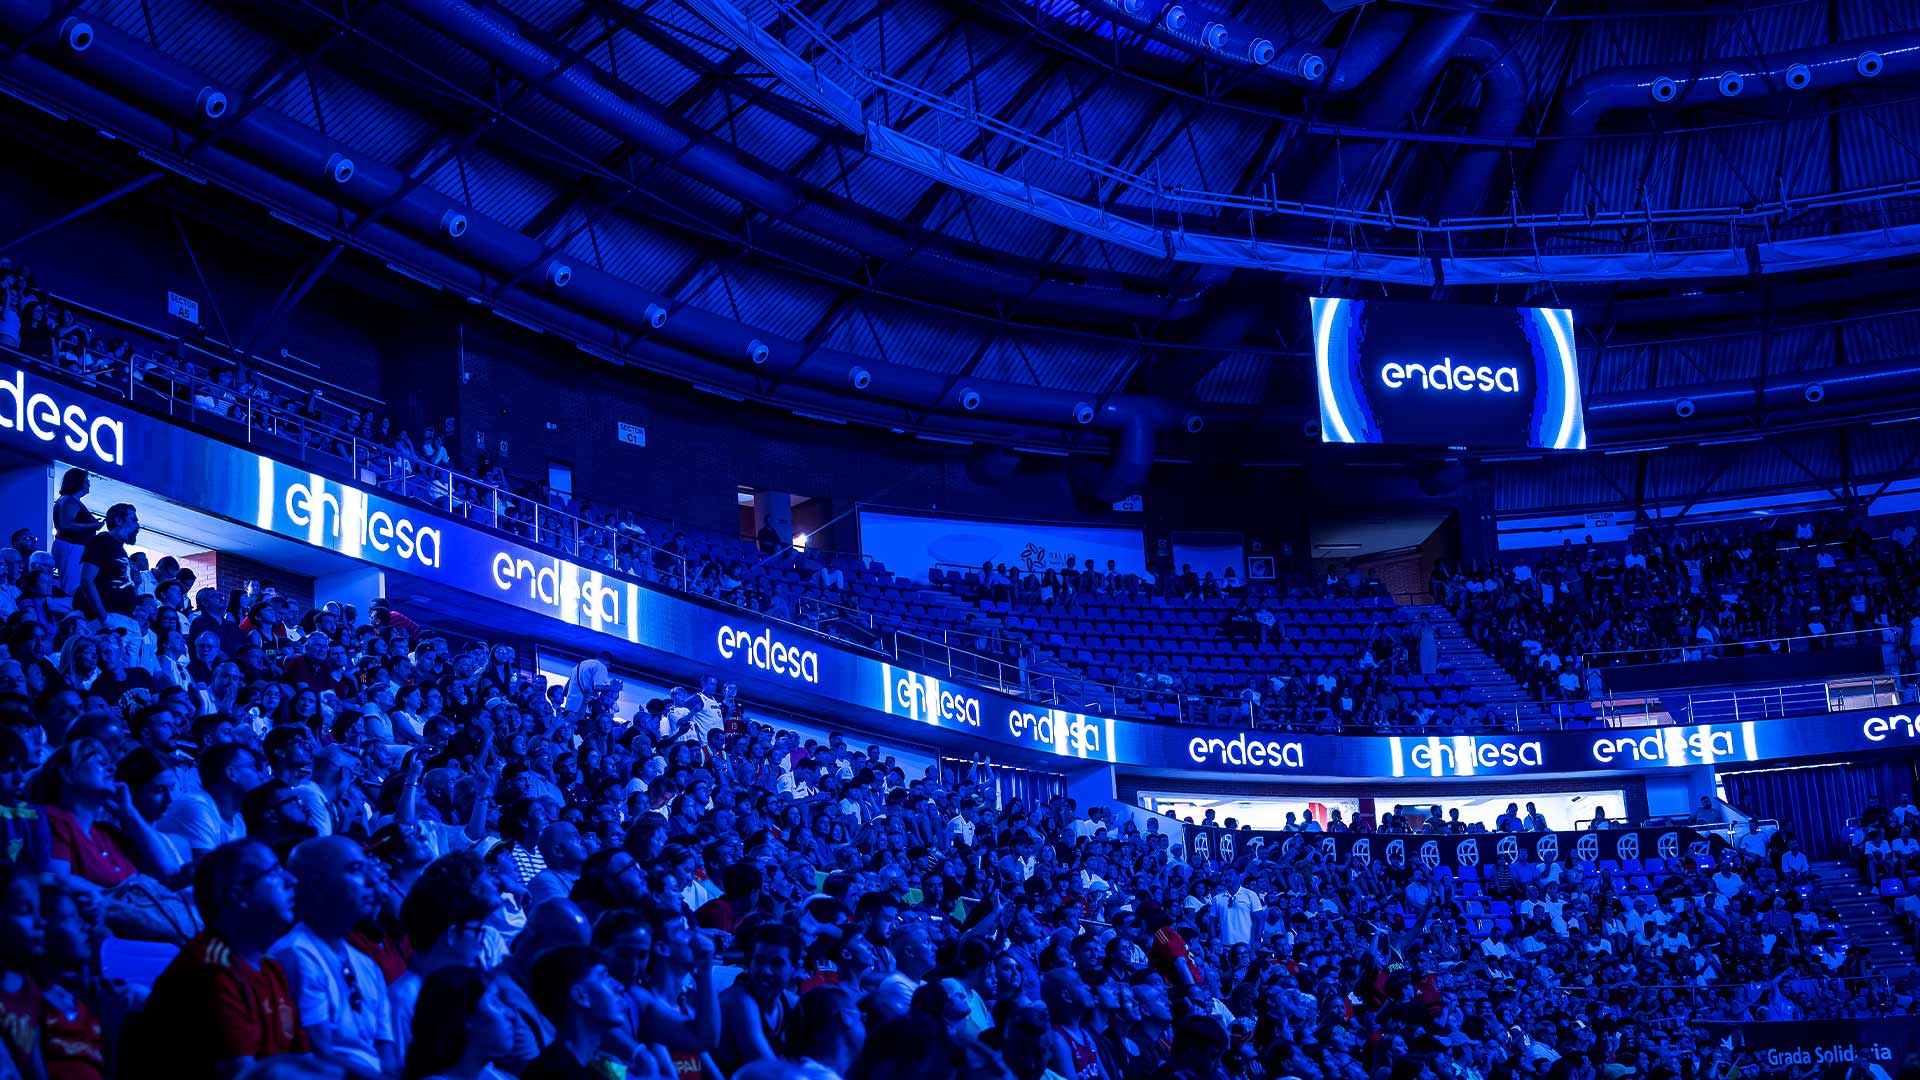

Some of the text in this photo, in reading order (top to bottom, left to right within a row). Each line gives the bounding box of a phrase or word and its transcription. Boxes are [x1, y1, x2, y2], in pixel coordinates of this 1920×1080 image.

[1382, 357, 1519, 392] endesa
[717, 625, 818, 683] endesa
[1863, 713, 1920, 742] en
[1189, 733, 1304, 767] endesa
[1767, 1044, 1892, 1065] Grada Solidia
